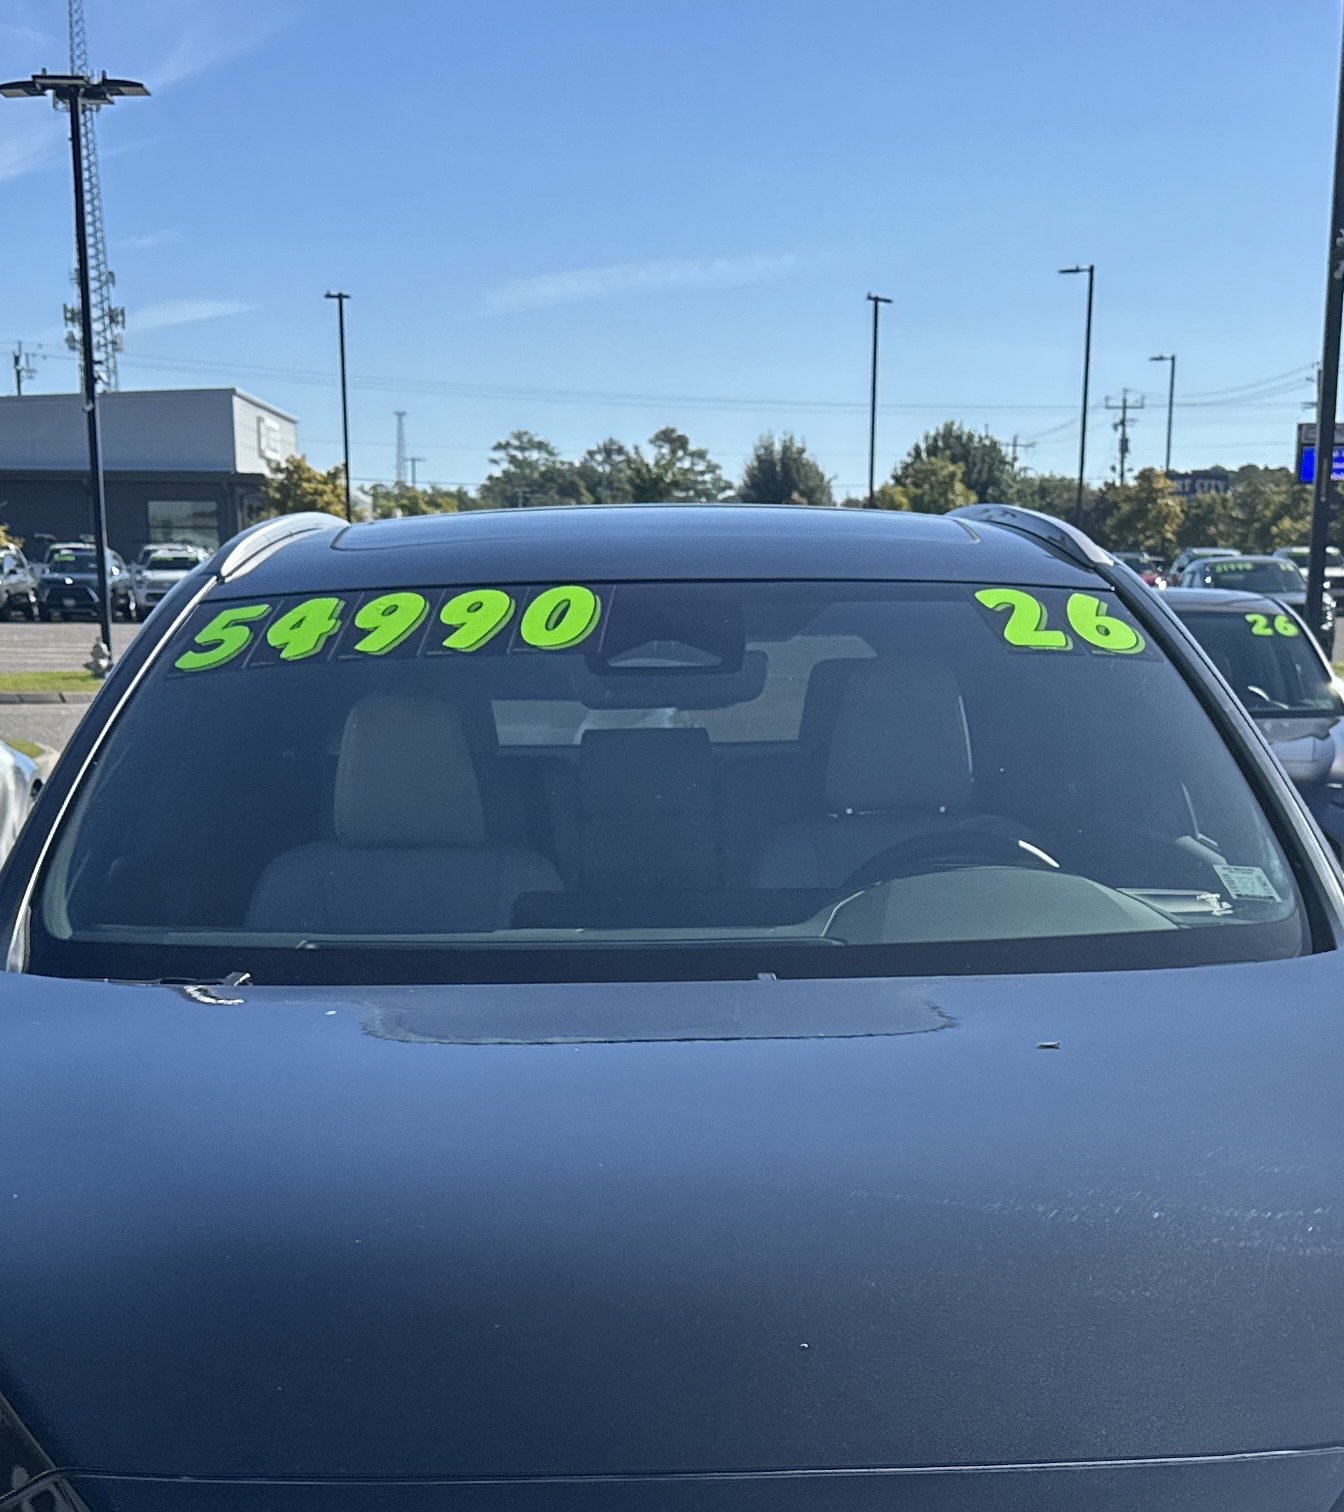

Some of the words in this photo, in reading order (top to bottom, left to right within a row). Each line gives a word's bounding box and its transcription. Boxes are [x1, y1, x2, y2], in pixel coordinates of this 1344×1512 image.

[175, 585, 601, 672] 54990
[975, 588, 1146, 655] 26
[1244, 613, 1300, 637] 26
